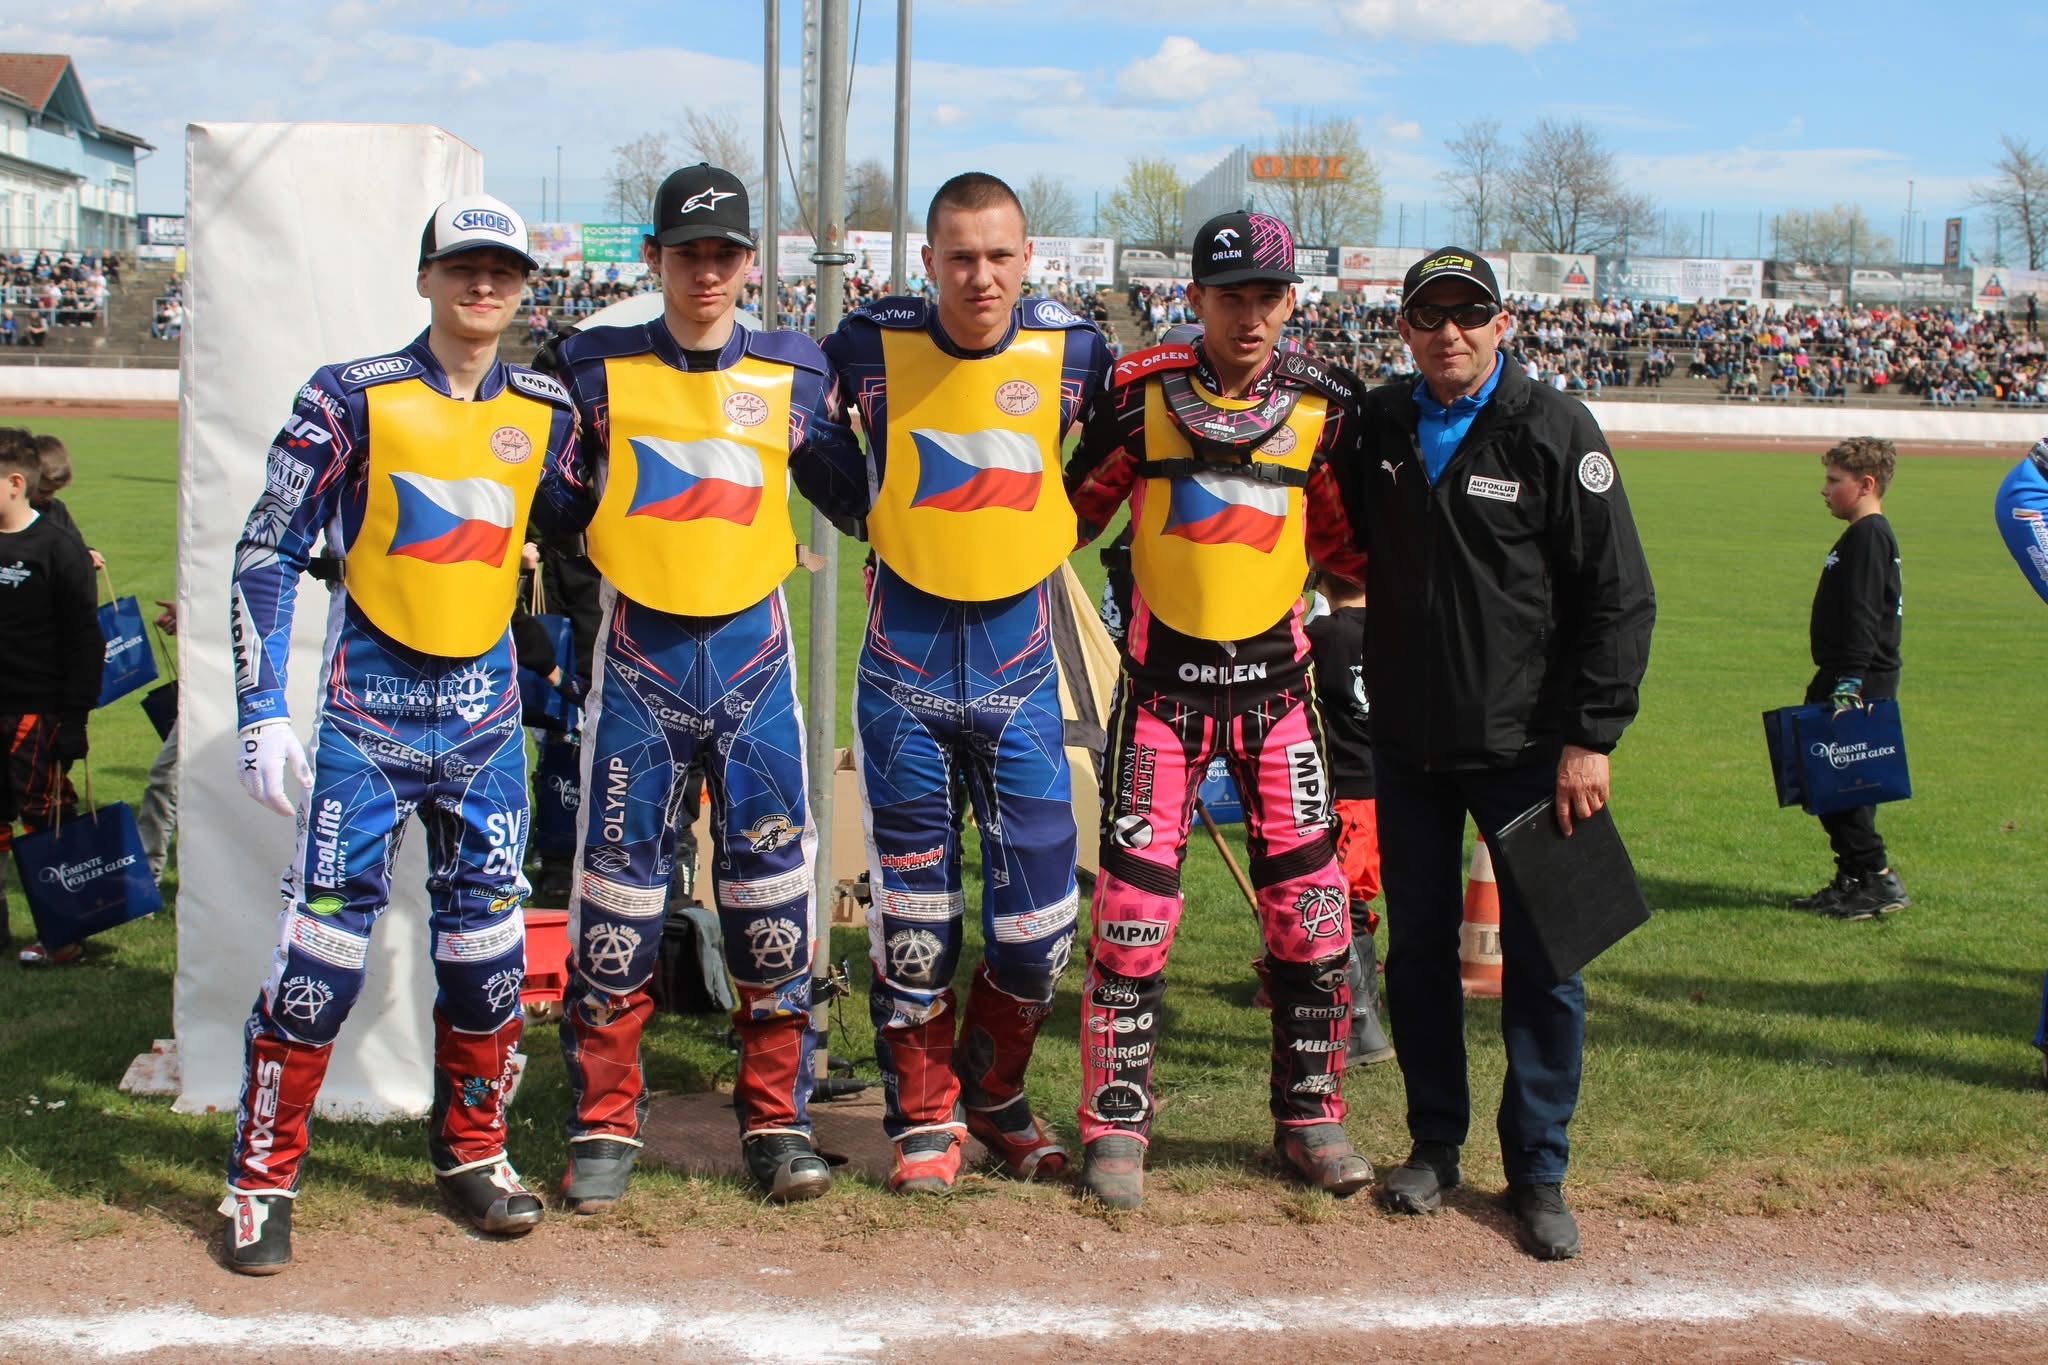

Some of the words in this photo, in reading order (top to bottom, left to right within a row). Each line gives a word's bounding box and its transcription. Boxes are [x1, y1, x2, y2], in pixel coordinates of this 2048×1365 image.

[1252, 155, 1346, 179] OBI
[461, 212, 513, 235] SHOEI
[1212, 250, 1242, 261] ORLEN
[351, 359, 406, 380] SHOEI
[1142, 351, 1189, 368] ORLEN
[521, 375, 563, 396] MPM
[1307, 366, 1352, 398] OLYMP
[1204, 422, 1236, 433] BUBBA
[1471, 480, 1516, 492] AUTOKLUB
[1179, 662, 1268, 684] ORLEN
[911, 693, 965, 716] CZECH
[659, 708, 715, 731] CZECH
[377, 742, 433, 767] CZECH
[1811, 742, 1868, 762] MOMENTE
[1868, 745, 1896, 758] GLÜCK
[1121, 744, 1137, 811] PERSONAL
[1137, 747, 1157, 815] REALITY
[1294, 751, 1322, 825] MPM
[603, 757, 631, 843] OLYMP
[486, 809, 522, 846] SV
[314, 798, 342, 889] EcoLifts
[105, 855, 136, 874] GLÜCK
[482, 844, 520, 877] CK
[1106, 922, 1160, 942] MPM
[1090, 1042, 1150, 1060] CONRADI
[1289, 1038, 1346, 1053] Mitas
[1126, 1057, 1149, 1069] Team
